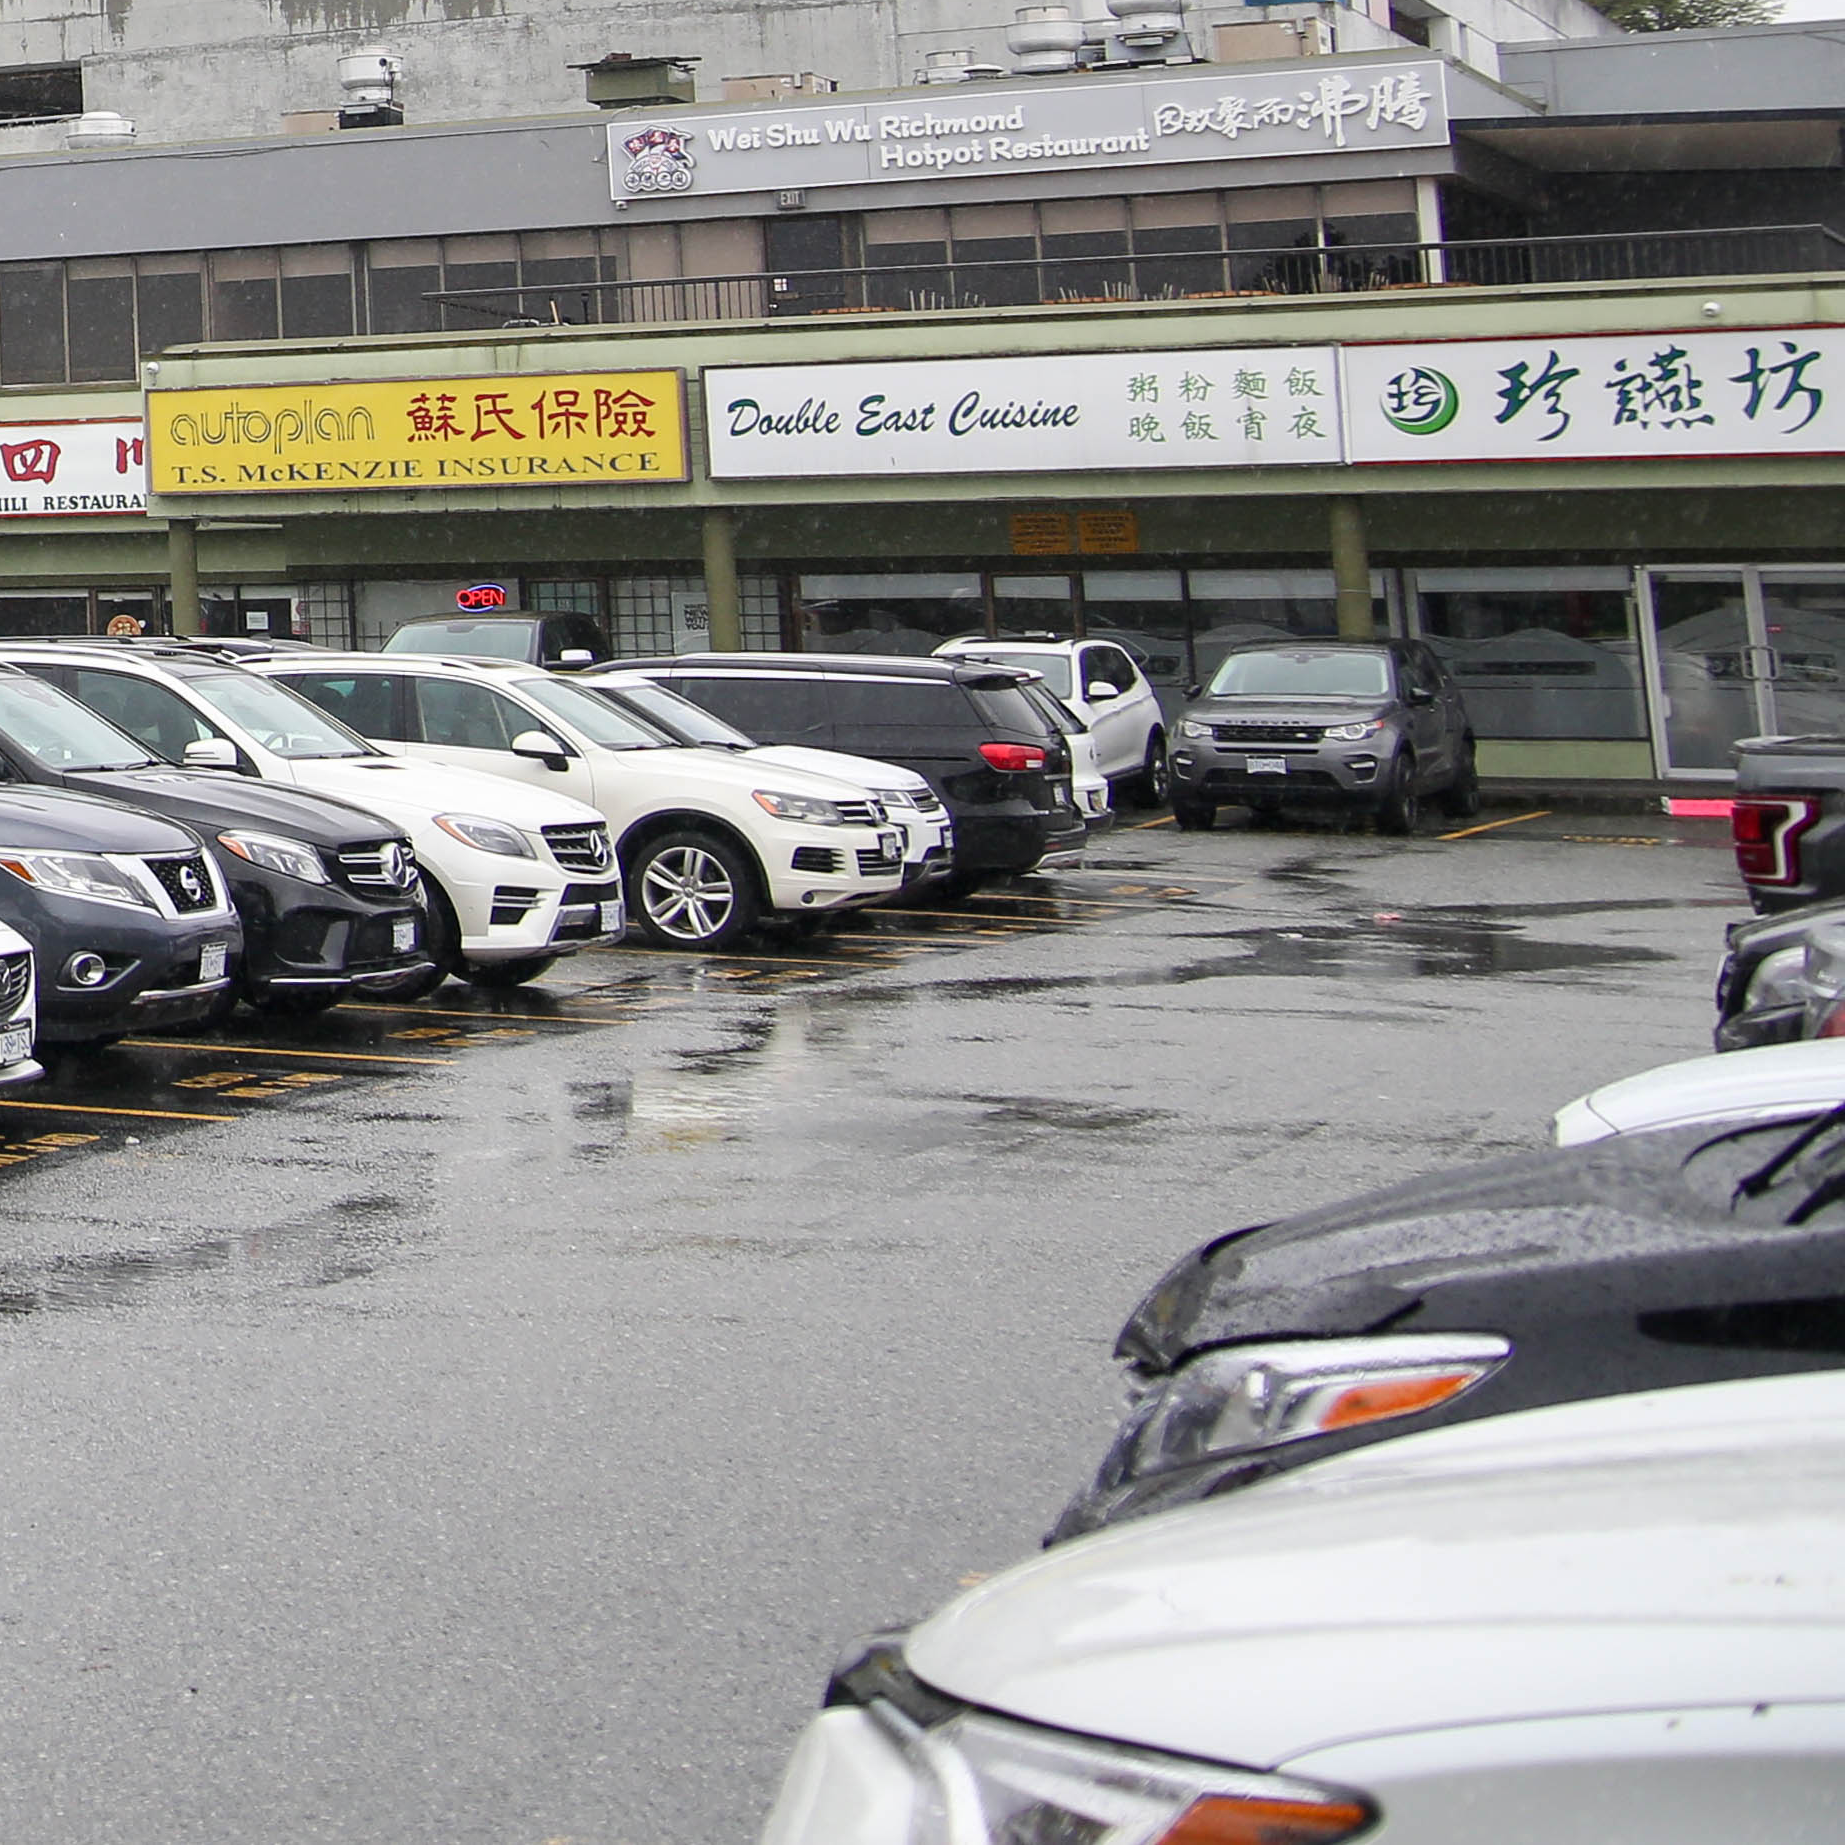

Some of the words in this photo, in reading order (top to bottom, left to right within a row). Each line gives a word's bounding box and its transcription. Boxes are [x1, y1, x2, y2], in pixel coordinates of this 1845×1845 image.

[708, 127, 761, 152] Wei
[766, 123, 820, 148] Shu
[826, 117, 870, 143] Wu
[879, 105, 1025, 139] Richmond
[881, 141, 985, 171] Hotpot
[990, 128, 1149, 162] Restaurant
[781, 190, 802, 206] EXIT
[171, 399, 375, 454] autoplan
[406, 389, 657, 442] 蘇氏保險
[728, 398, 842, 438] Double
[855, 394, 936, 436] East
[948, 390, 1079, 436] Cuisine
[172, 465, 226, 484] T.S.
[238, 458, 421, 482] McKENZIE
[438, 453, 659, 477] INSURANCE
[43, 493, 146, 510] RESTAURA
[456, 589, 505, 606] OPEN
